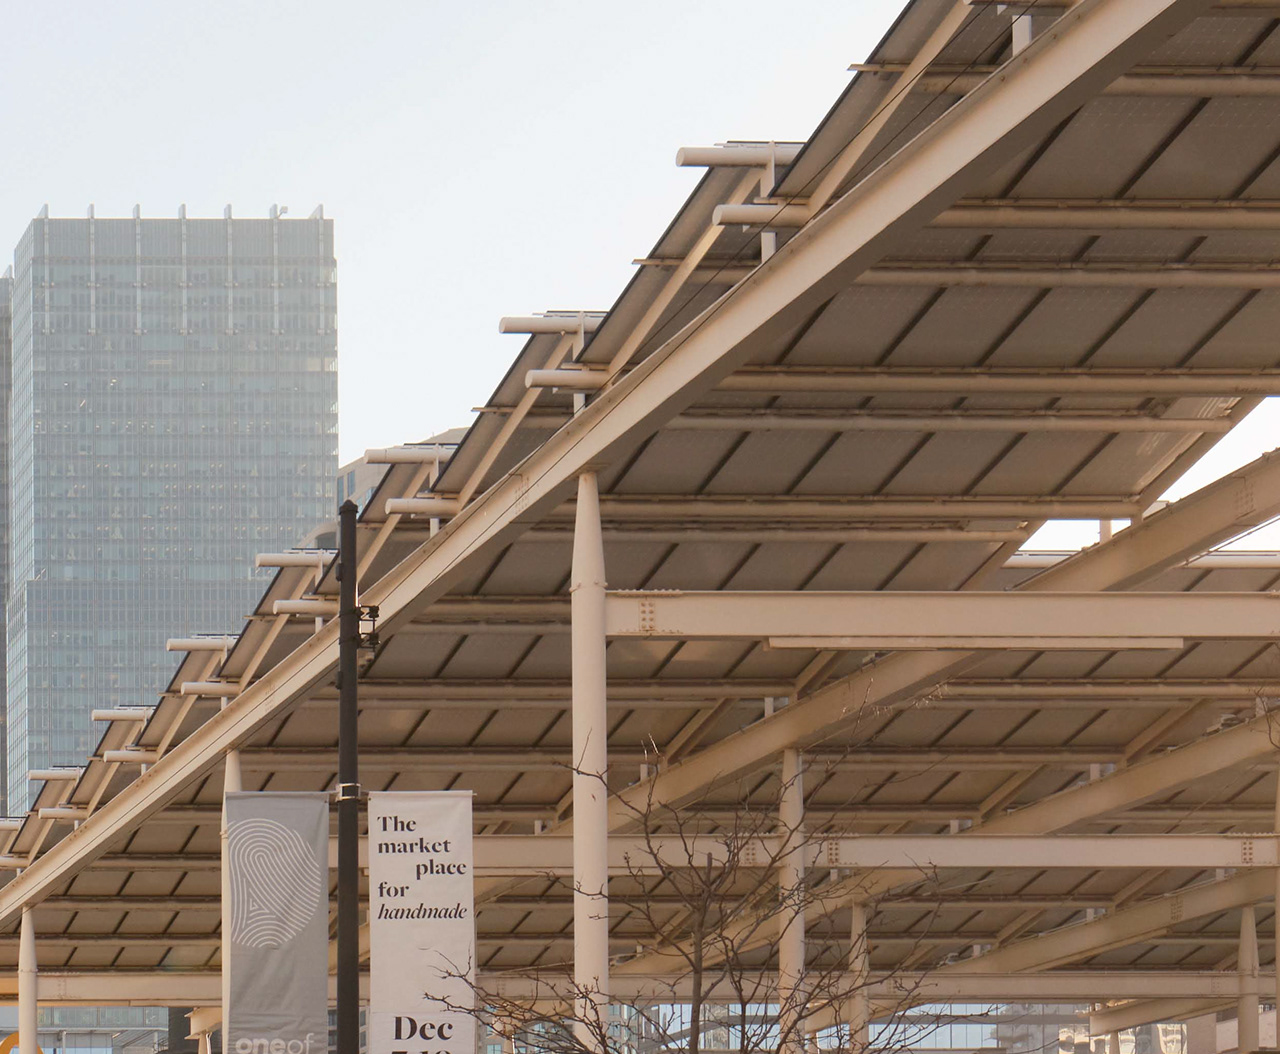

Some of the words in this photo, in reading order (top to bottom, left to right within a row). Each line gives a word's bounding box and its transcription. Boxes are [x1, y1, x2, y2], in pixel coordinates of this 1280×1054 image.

[377, 816, 416, 831] The
[378, 837, 451, 853] market
[416, 858, 467, 880] place
[378, 881, 409, 897] for
[378, 903, 467, 920] handmade
[394, 1016, 453, 1040] Dec
